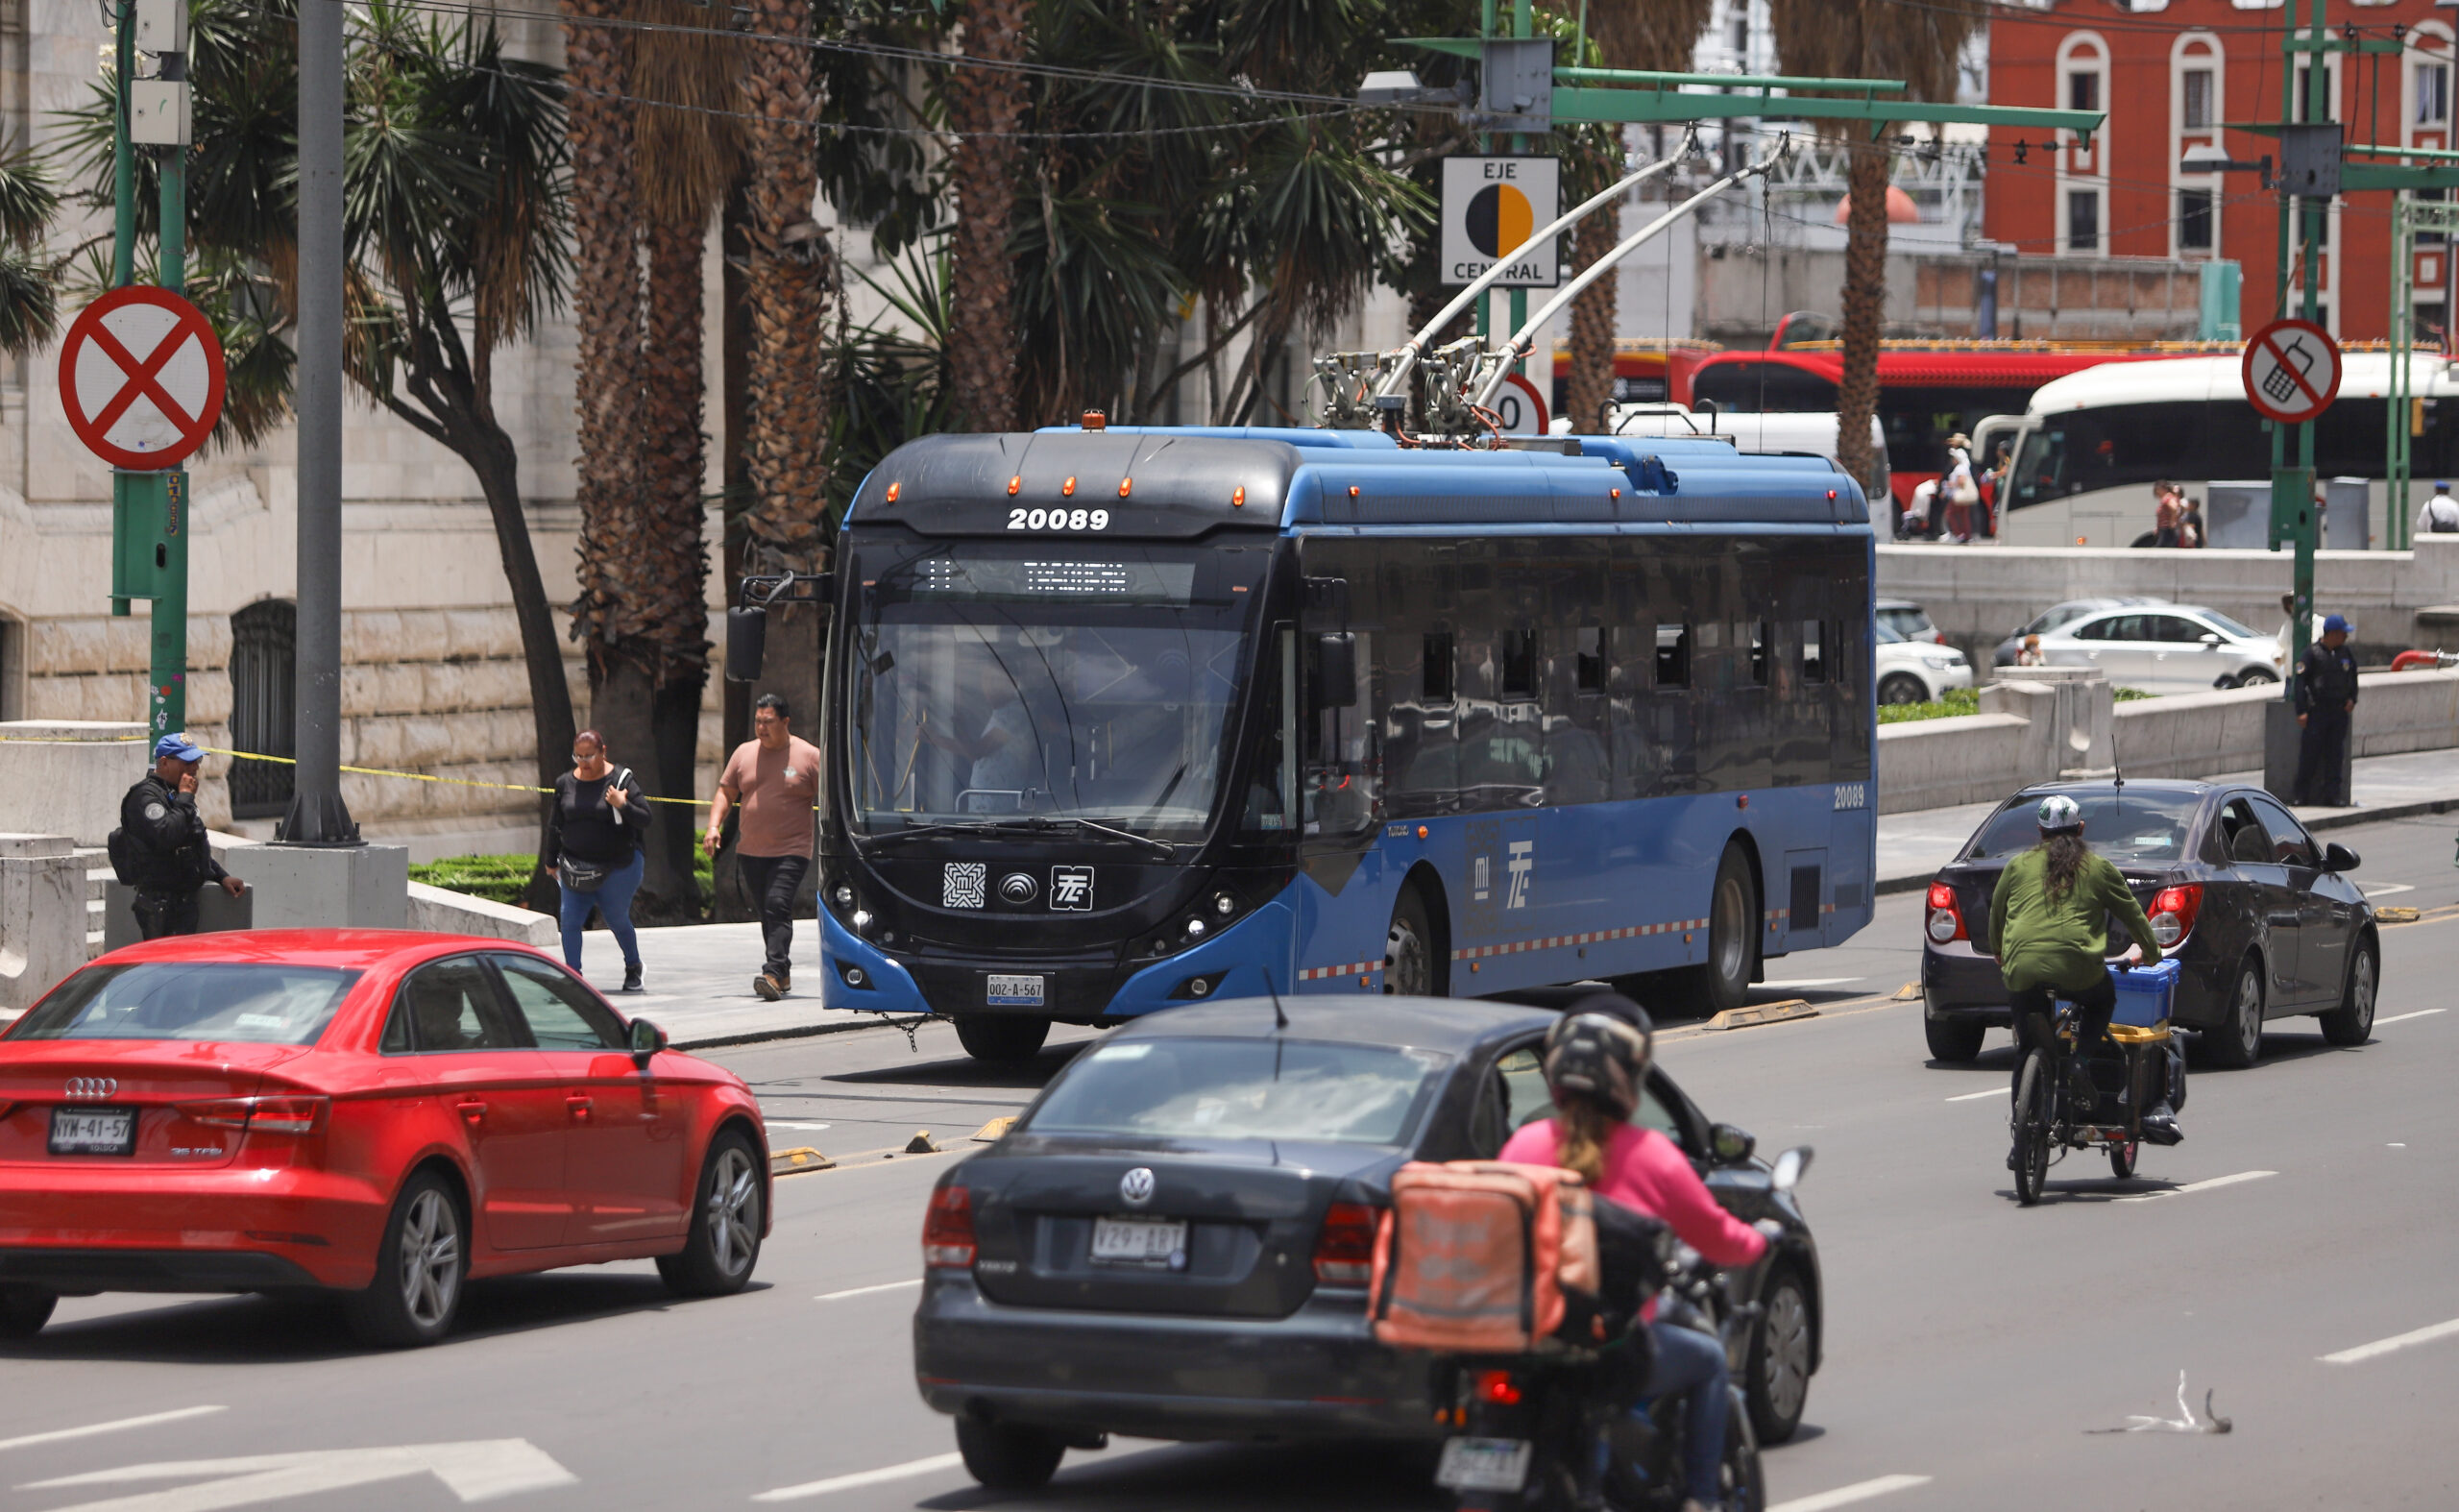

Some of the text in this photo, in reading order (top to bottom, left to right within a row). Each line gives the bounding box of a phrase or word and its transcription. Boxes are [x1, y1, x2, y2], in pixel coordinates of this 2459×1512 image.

[1484, 162, 1517, 179] EJE
[1453, 262, 1543, 280] CENRAL
[1008, 508, 1109, 530] 20089
[1835, 784, 1864, 809] 20089
[989, 983, 1042, 996] 002-A-567
